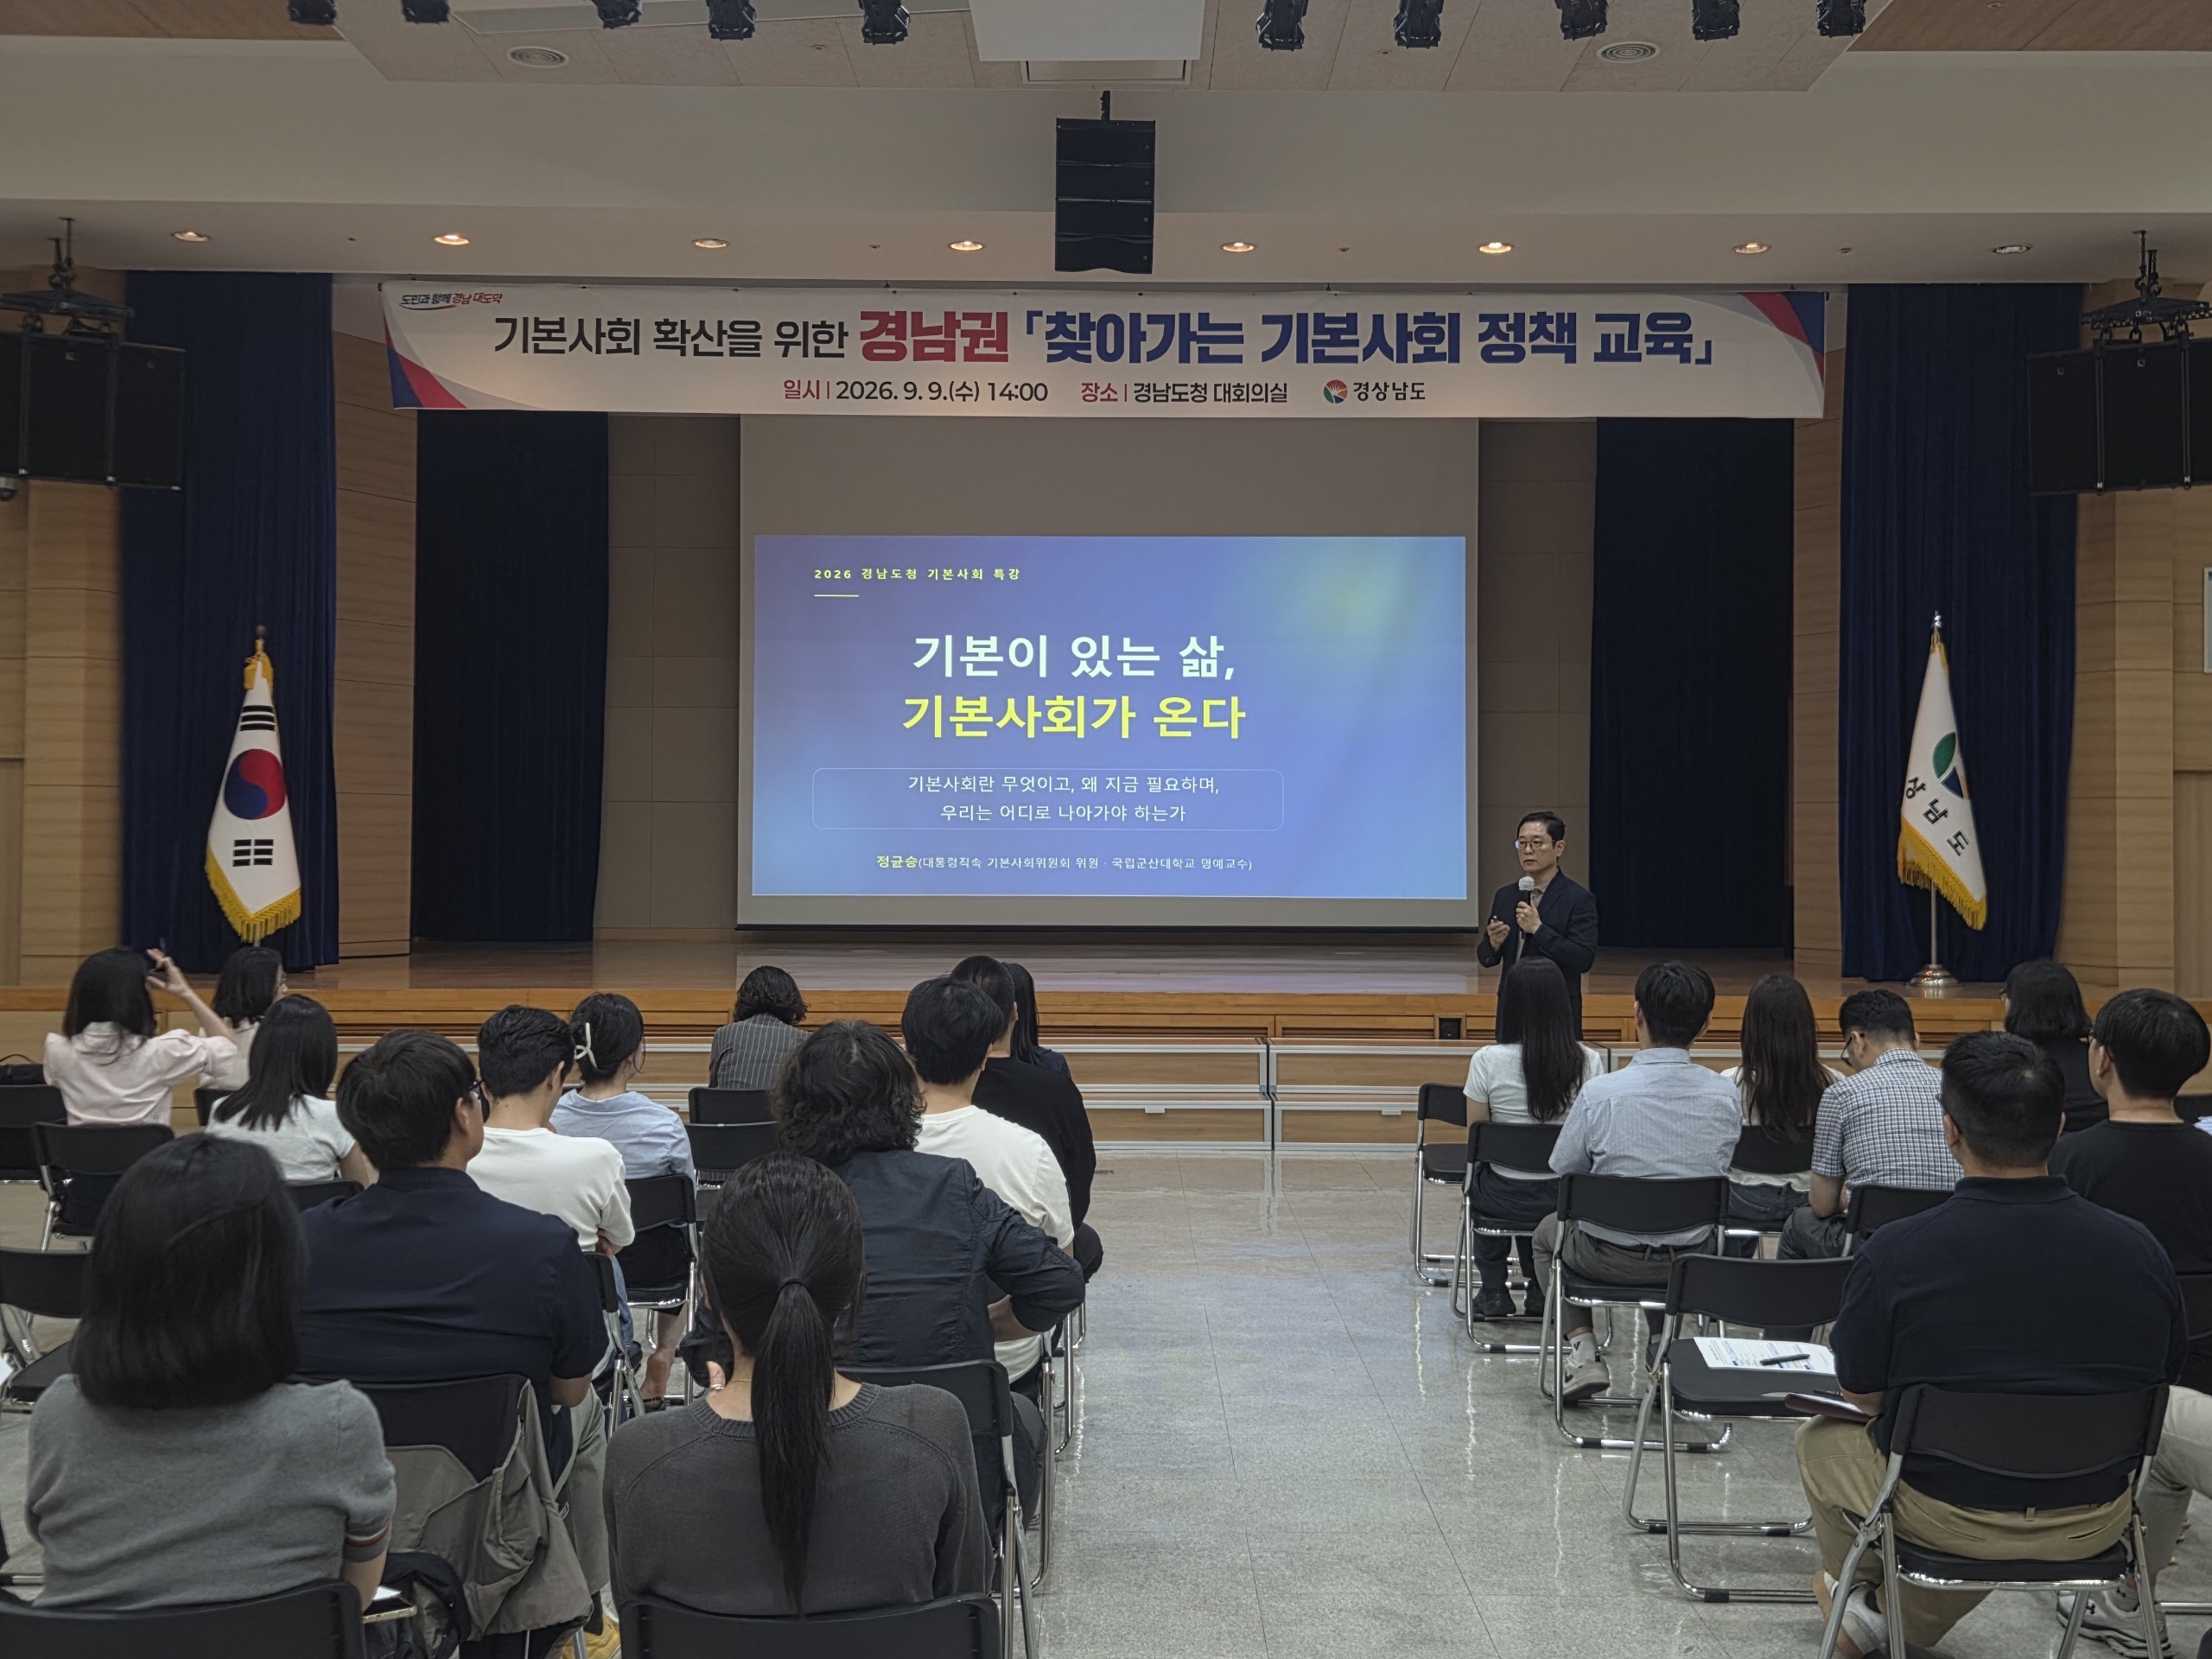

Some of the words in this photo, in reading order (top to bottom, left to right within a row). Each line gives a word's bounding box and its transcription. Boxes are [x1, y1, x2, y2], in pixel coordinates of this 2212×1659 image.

[473, 292, 503, 304] 대도약
[494, 316, 640, 356] 기본사회
[653, 318, 762, 358] 확산을
[775, 320, 849, 359] 위한
[860, 310, 1009, 363] 경남권
[1026, 309, 1244, 364] 「찾아가는
[1262, 311, 1460, 364] 기본사회
[1478, 311, 1577, 365] 정책
[1594, 312, 1713, 366] 교육」
[784, 379, 820, 400] 일시
[988, 382, 1048, 402] 14:00
[1081, 382, 1118, 403] 장소
[1134, 382, 1208, 404] 경남도청
[1213, 382, 1287, 404] 대회의실
[1353, 381, 1426, 402] 경상남도
[814, 569, 851, 579] 2026
[861, 568, 917, 580] 경남도청
[927, 568, 983, 581] 기본사회
[993, 568, 1020, 581] 특강
[912, 634, 1047, 678] 기본이
[1071, 635, 1160, 678] 있는
[1179, 635, 1235, 682] 삶,
[902, 695, 1136, 739] 기본사회가
[1153, 696, 1246, 739] 온다
[908, 775, 995, 792] 기본사회란
[1001, 776, 1075, 794] 무엇이고,
[1081, 776, 1097, 793] 왜
[1105, 776, 1140, 793] 지금
[1147, 776, 1219, 795] 필요하며,
[940, 804, 993, 822] 우리는
[1000, 804, 1052, 822] 어디로
[1058, 804, 1128, 822] 나아가야
[1134, 804, 1186, 822] 하는가
[987, 857, 1070, 869] 기본사회위원회
[1076, 857, 1098, 869] 위원
[1112, 857, 1195, 869] 국립군산대학교
[1201, 857, 1252, 871] 명예교수)
